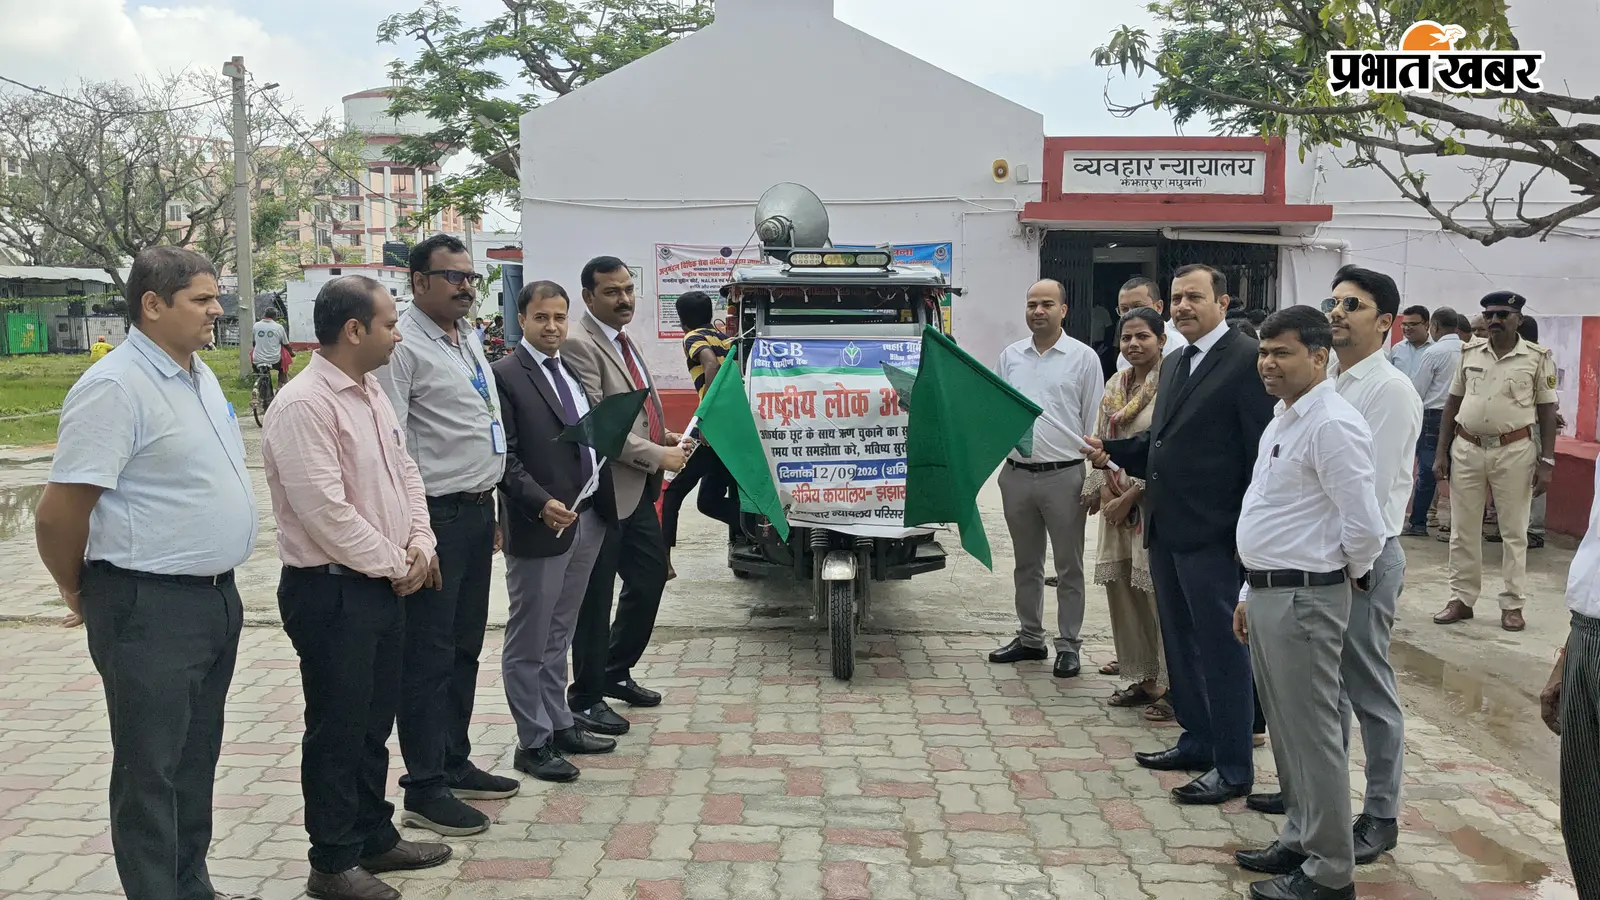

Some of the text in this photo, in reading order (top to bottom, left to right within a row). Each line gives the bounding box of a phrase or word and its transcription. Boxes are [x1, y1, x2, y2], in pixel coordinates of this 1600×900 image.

[1073, 158, 1255, 177] व्यवहार न्यायालय
[759, 340, 803, 357] BGB
[756, 385, 817, 426] राष्ट्रीय
[823, 382, 871, 418] लोक
[805, 427, 815, 439] के
[818, 429, 836, 439] साथ
[858, 425, 883, 441] चुकाने
[886, 427, 898, 437] का
[791, 446, 803, 456] पर
[805, 443, 841, 456] समझौता
[779, 466, 812, 479] दिनांक
[857, 467, 878, 476] 2026
